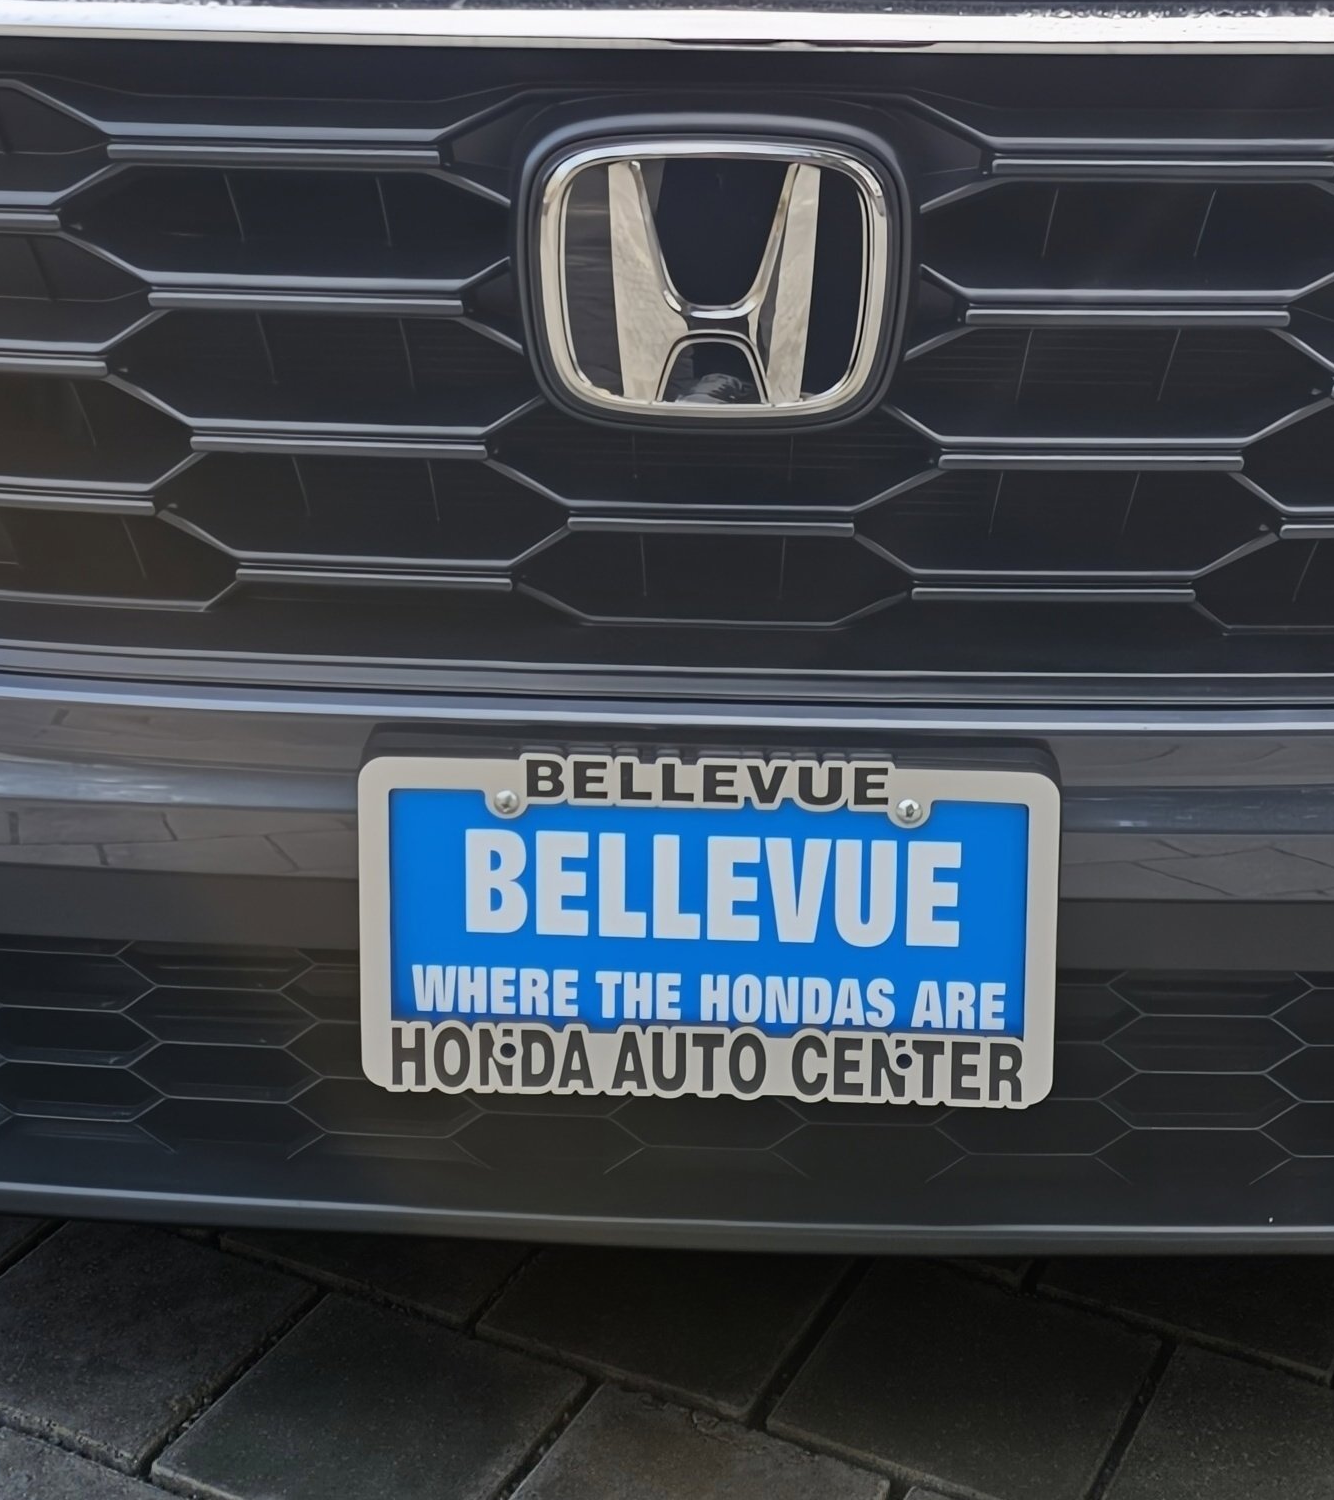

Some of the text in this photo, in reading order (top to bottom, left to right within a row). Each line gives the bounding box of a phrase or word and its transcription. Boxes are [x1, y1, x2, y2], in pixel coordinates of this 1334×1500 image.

[526, 758, 890, 808] BELLEVUE
[465, 828, 962, 948] BELLEVUE
[411, 964, 1006, 1031] WHERE THE HONDAS ARE
[390, 1027, 1023, 1103] HONDA AUTO CENTER
